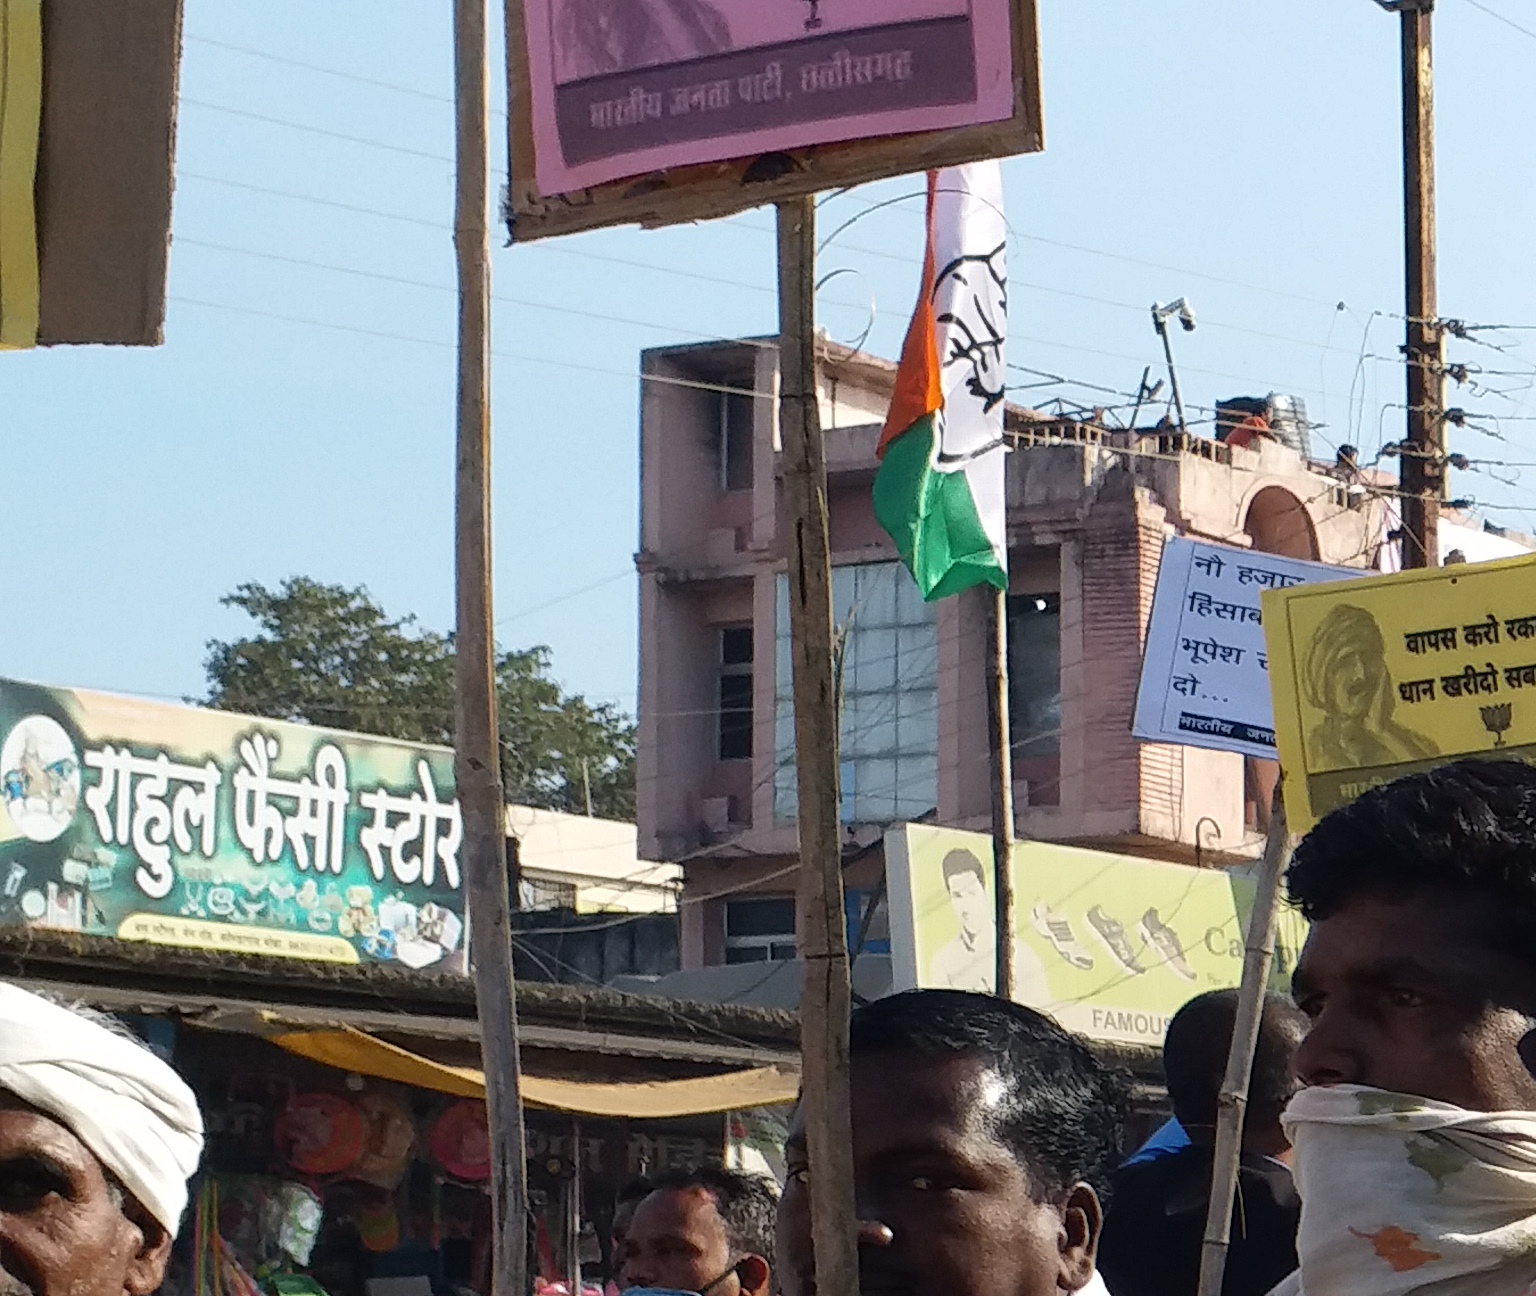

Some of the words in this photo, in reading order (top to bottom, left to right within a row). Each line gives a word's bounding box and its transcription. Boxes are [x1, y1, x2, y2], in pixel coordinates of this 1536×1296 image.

[1193, 554, 1227, 579] नौ
[1182, 637, 1246, 666] भूपेश
[1404, 626, 1457, 656] वापस
[1464, 614, 1500, 647] करो
[1398, 680, 1436, 704] धान
[1441, 662, 1498, 697] खरीदो
[1179, 715, 1234, 736] भारतीय
[86, 744, 221, 898] राहुल
[234, 730, 348, 875] फैंसी
[361, 757, 465, 889] स्टोर
